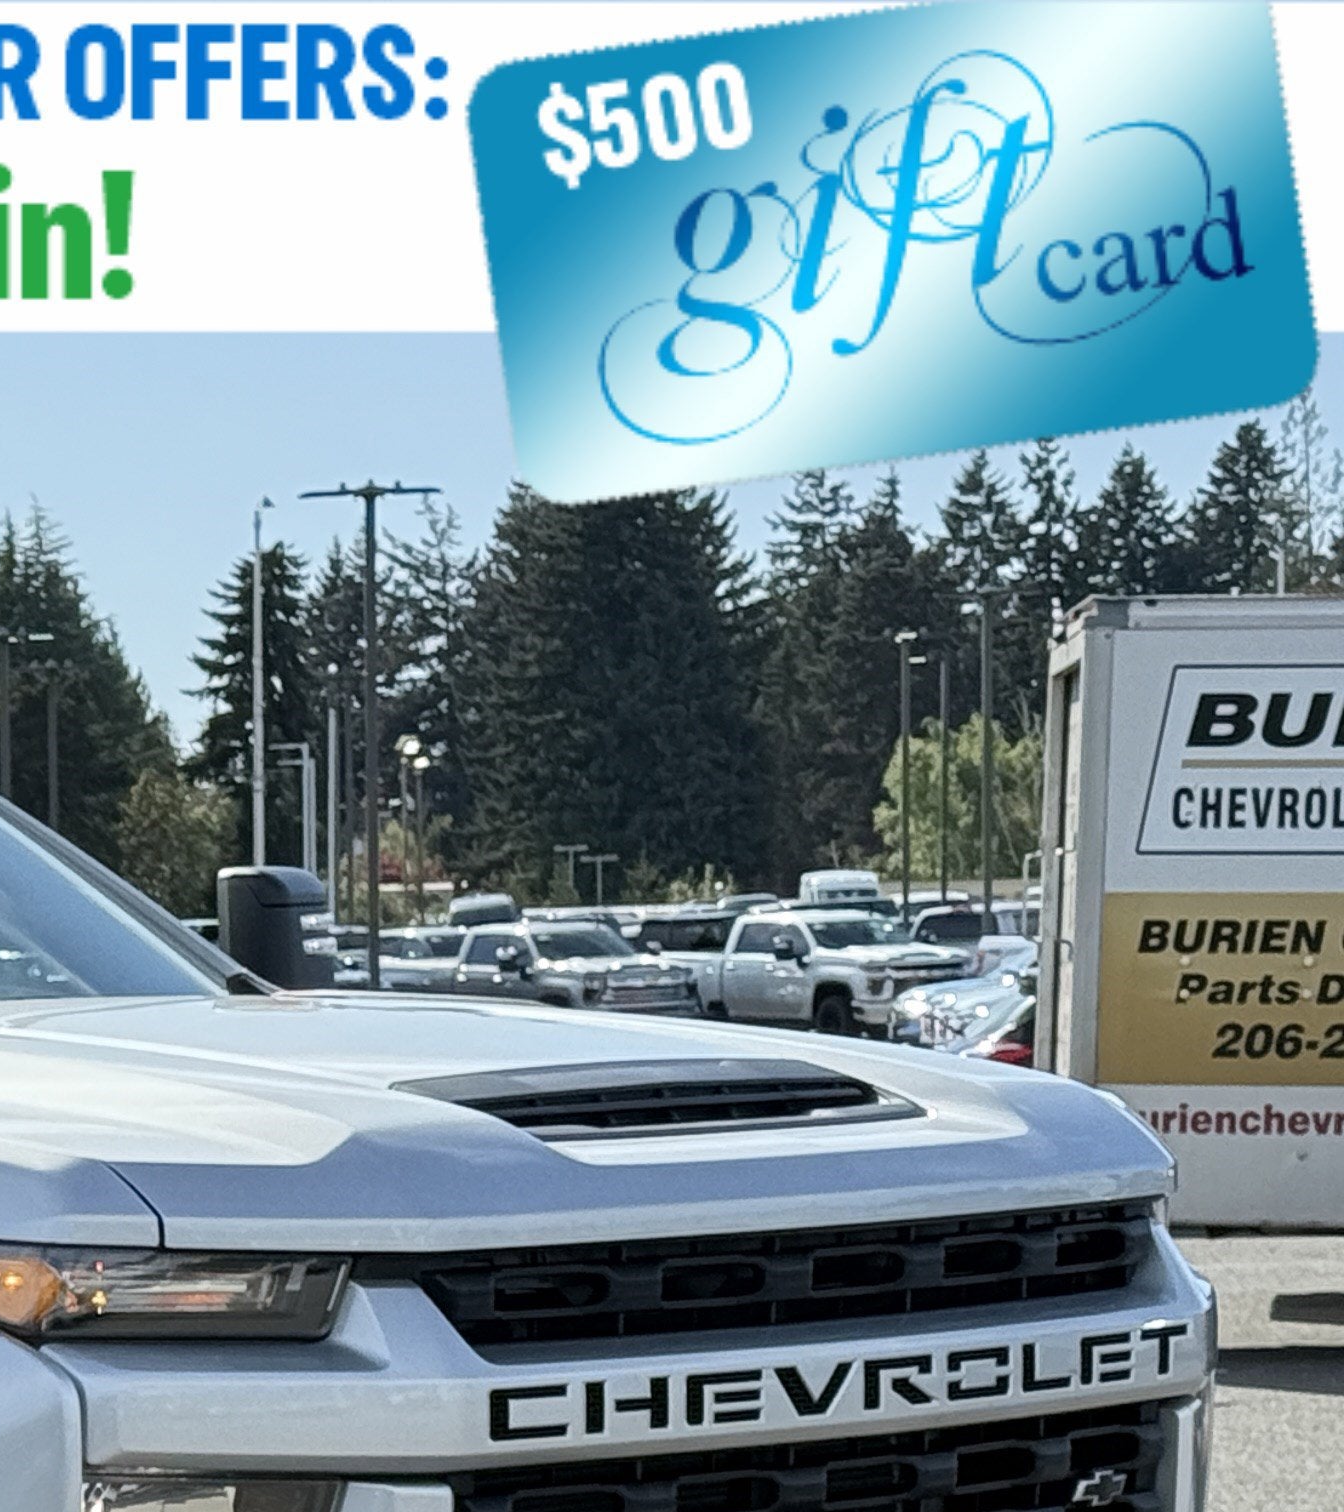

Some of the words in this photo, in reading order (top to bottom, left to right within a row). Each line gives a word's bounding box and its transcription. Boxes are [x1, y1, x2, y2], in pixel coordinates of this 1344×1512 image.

[1186, 692, 1344, 747] BU
[1138, 919, 1326, 954] BURIEN
[1176, 973, 1299, 1006] Parts
[489, 1323, 1189, 1442] CHEVROLET
